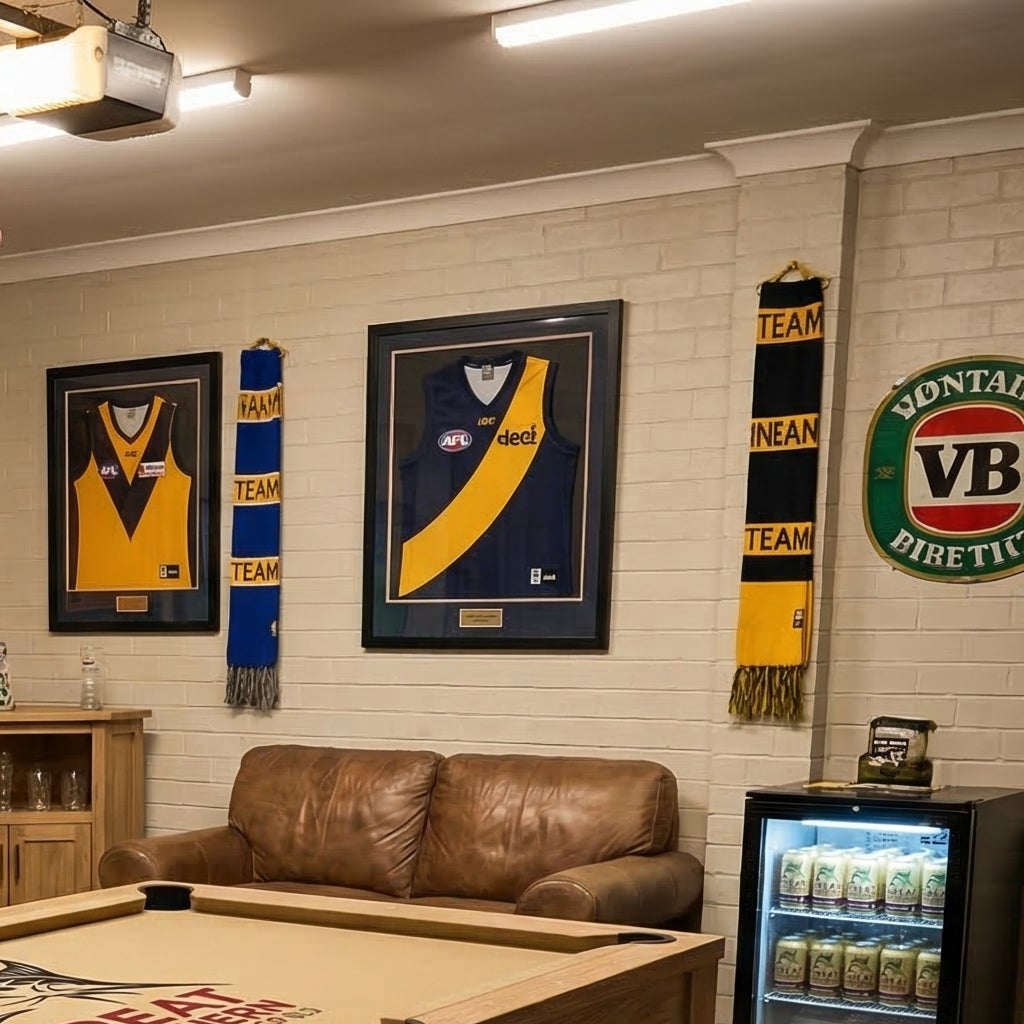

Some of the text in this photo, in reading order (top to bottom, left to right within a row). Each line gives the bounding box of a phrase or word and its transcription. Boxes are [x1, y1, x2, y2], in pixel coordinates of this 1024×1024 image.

[758, 305, 823, 339] TEAM
[441, 433, 469, 446] AFL
[914, 441, 1022, 499] VB
[234, 480, 280, 500] TEAM
[745, 527, 810, 551] TEAM
[231, 562, 279, 581] TEAM
